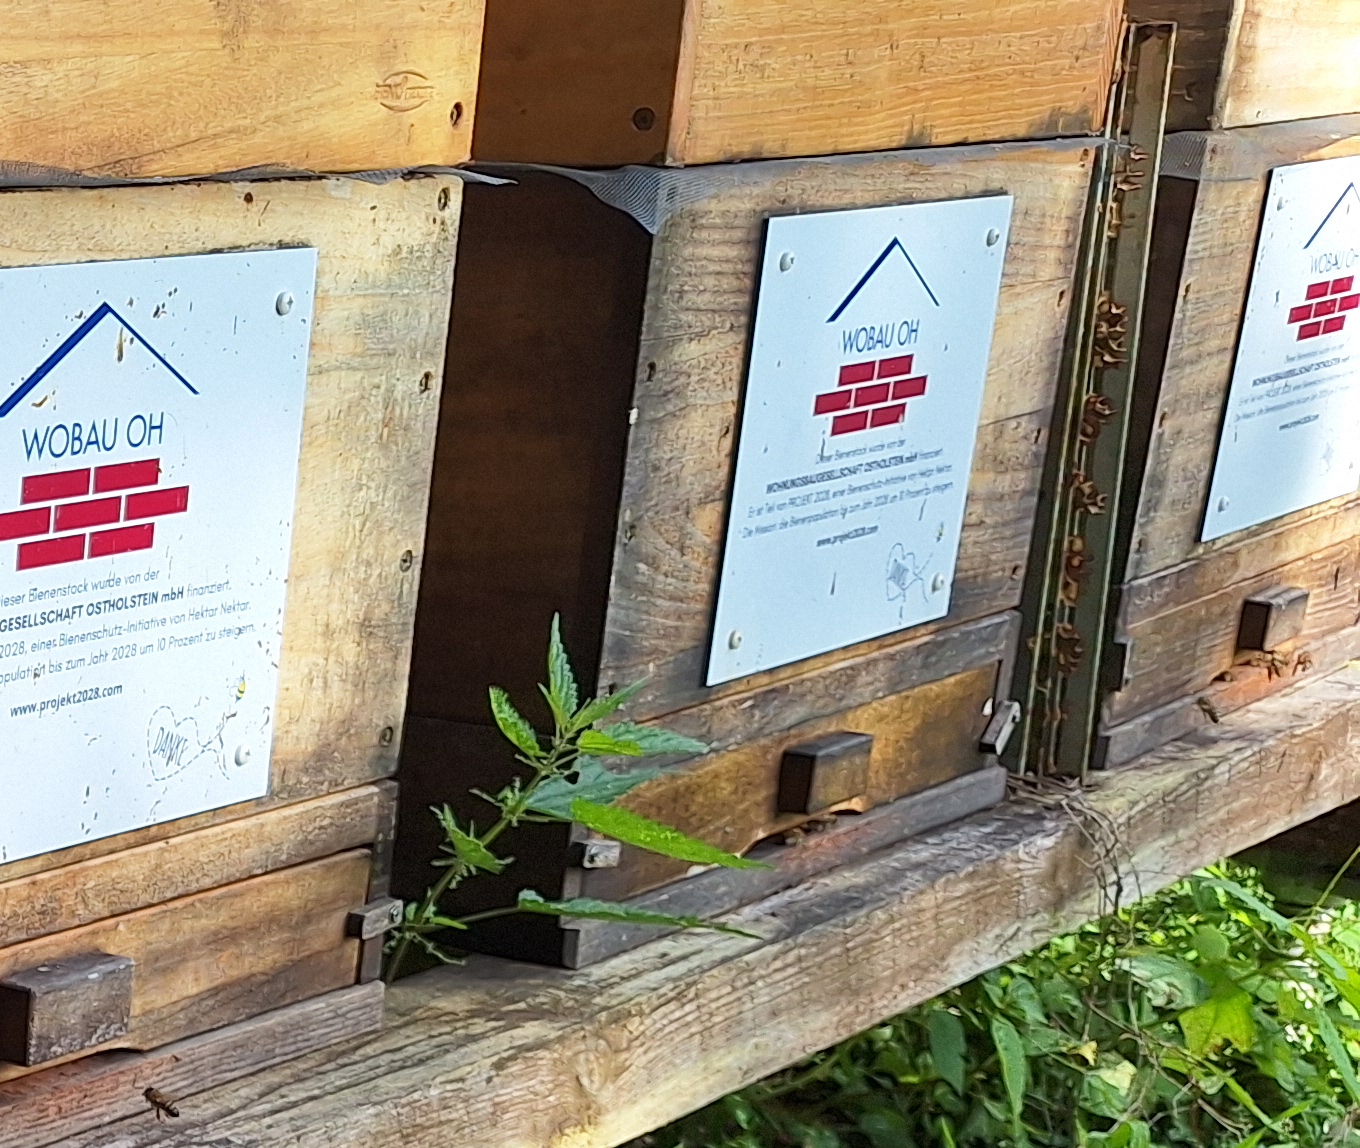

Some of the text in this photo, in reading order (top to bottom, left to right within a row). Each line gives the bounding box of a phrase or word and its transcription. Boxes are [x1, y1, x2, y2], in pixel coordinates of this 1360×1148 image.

[842, 318, 920, 355] WOBAU OH
[22, 411, 164, 462] WOBAU OH
[28, 580, 88, 603] Bienenstock
[91, 572, 121, 592] wurde
[124, 573, 139, 586] von
[143, 568, 159, 583] der
[86, 591, 159, 617] OSTHOLSTEIN
[161, 587, 184, 603] mbH
[169, 613, 185, 624] von
[189, 606, 217, 621] Hektar
[220, 599, 251, 615] Nektar.
[49, 658, 63, 674] bis
[66, 655, 84, 669] zum
[112, 642, 137, 662] 2028
[140, 643, 153, 655] um
[169, 631, 202, 650] Prozent
[205, 630, 216, 641] zu
[10, 682, 122, 717] www.projekt2028.com
